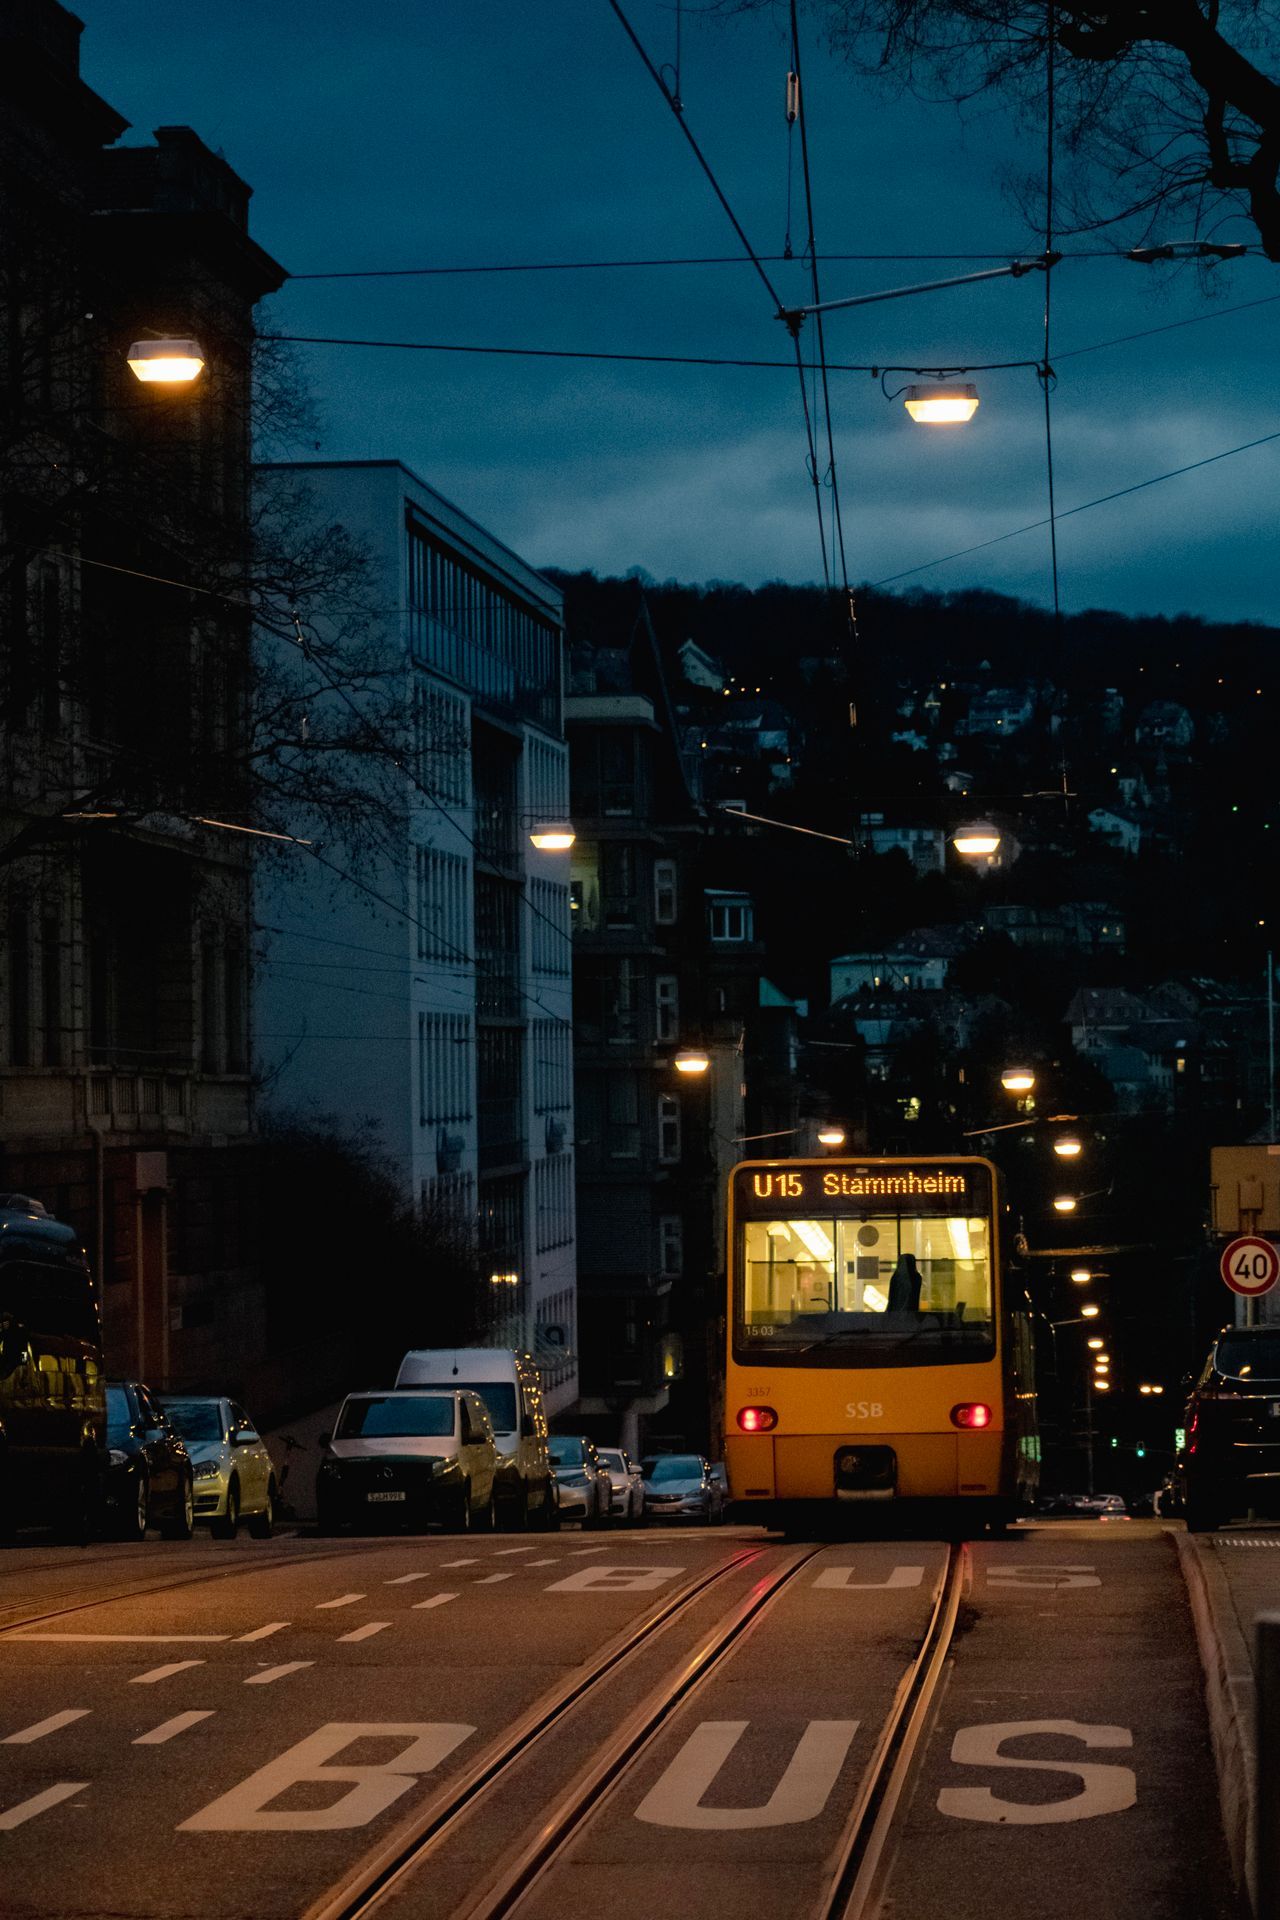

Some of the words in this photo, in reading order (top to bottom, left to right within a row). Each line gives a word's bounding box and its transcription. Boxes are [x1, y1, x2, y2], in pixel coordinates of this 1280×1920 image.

[753, 1173, 803, 1198] U15
[822, 1171, 966, 1196] Stammheim
[1234, 1253, 1268, 1280] 40
[845, 1401, 884, 1419] SSB
[174, 1718, 1138, 1830] BUS
